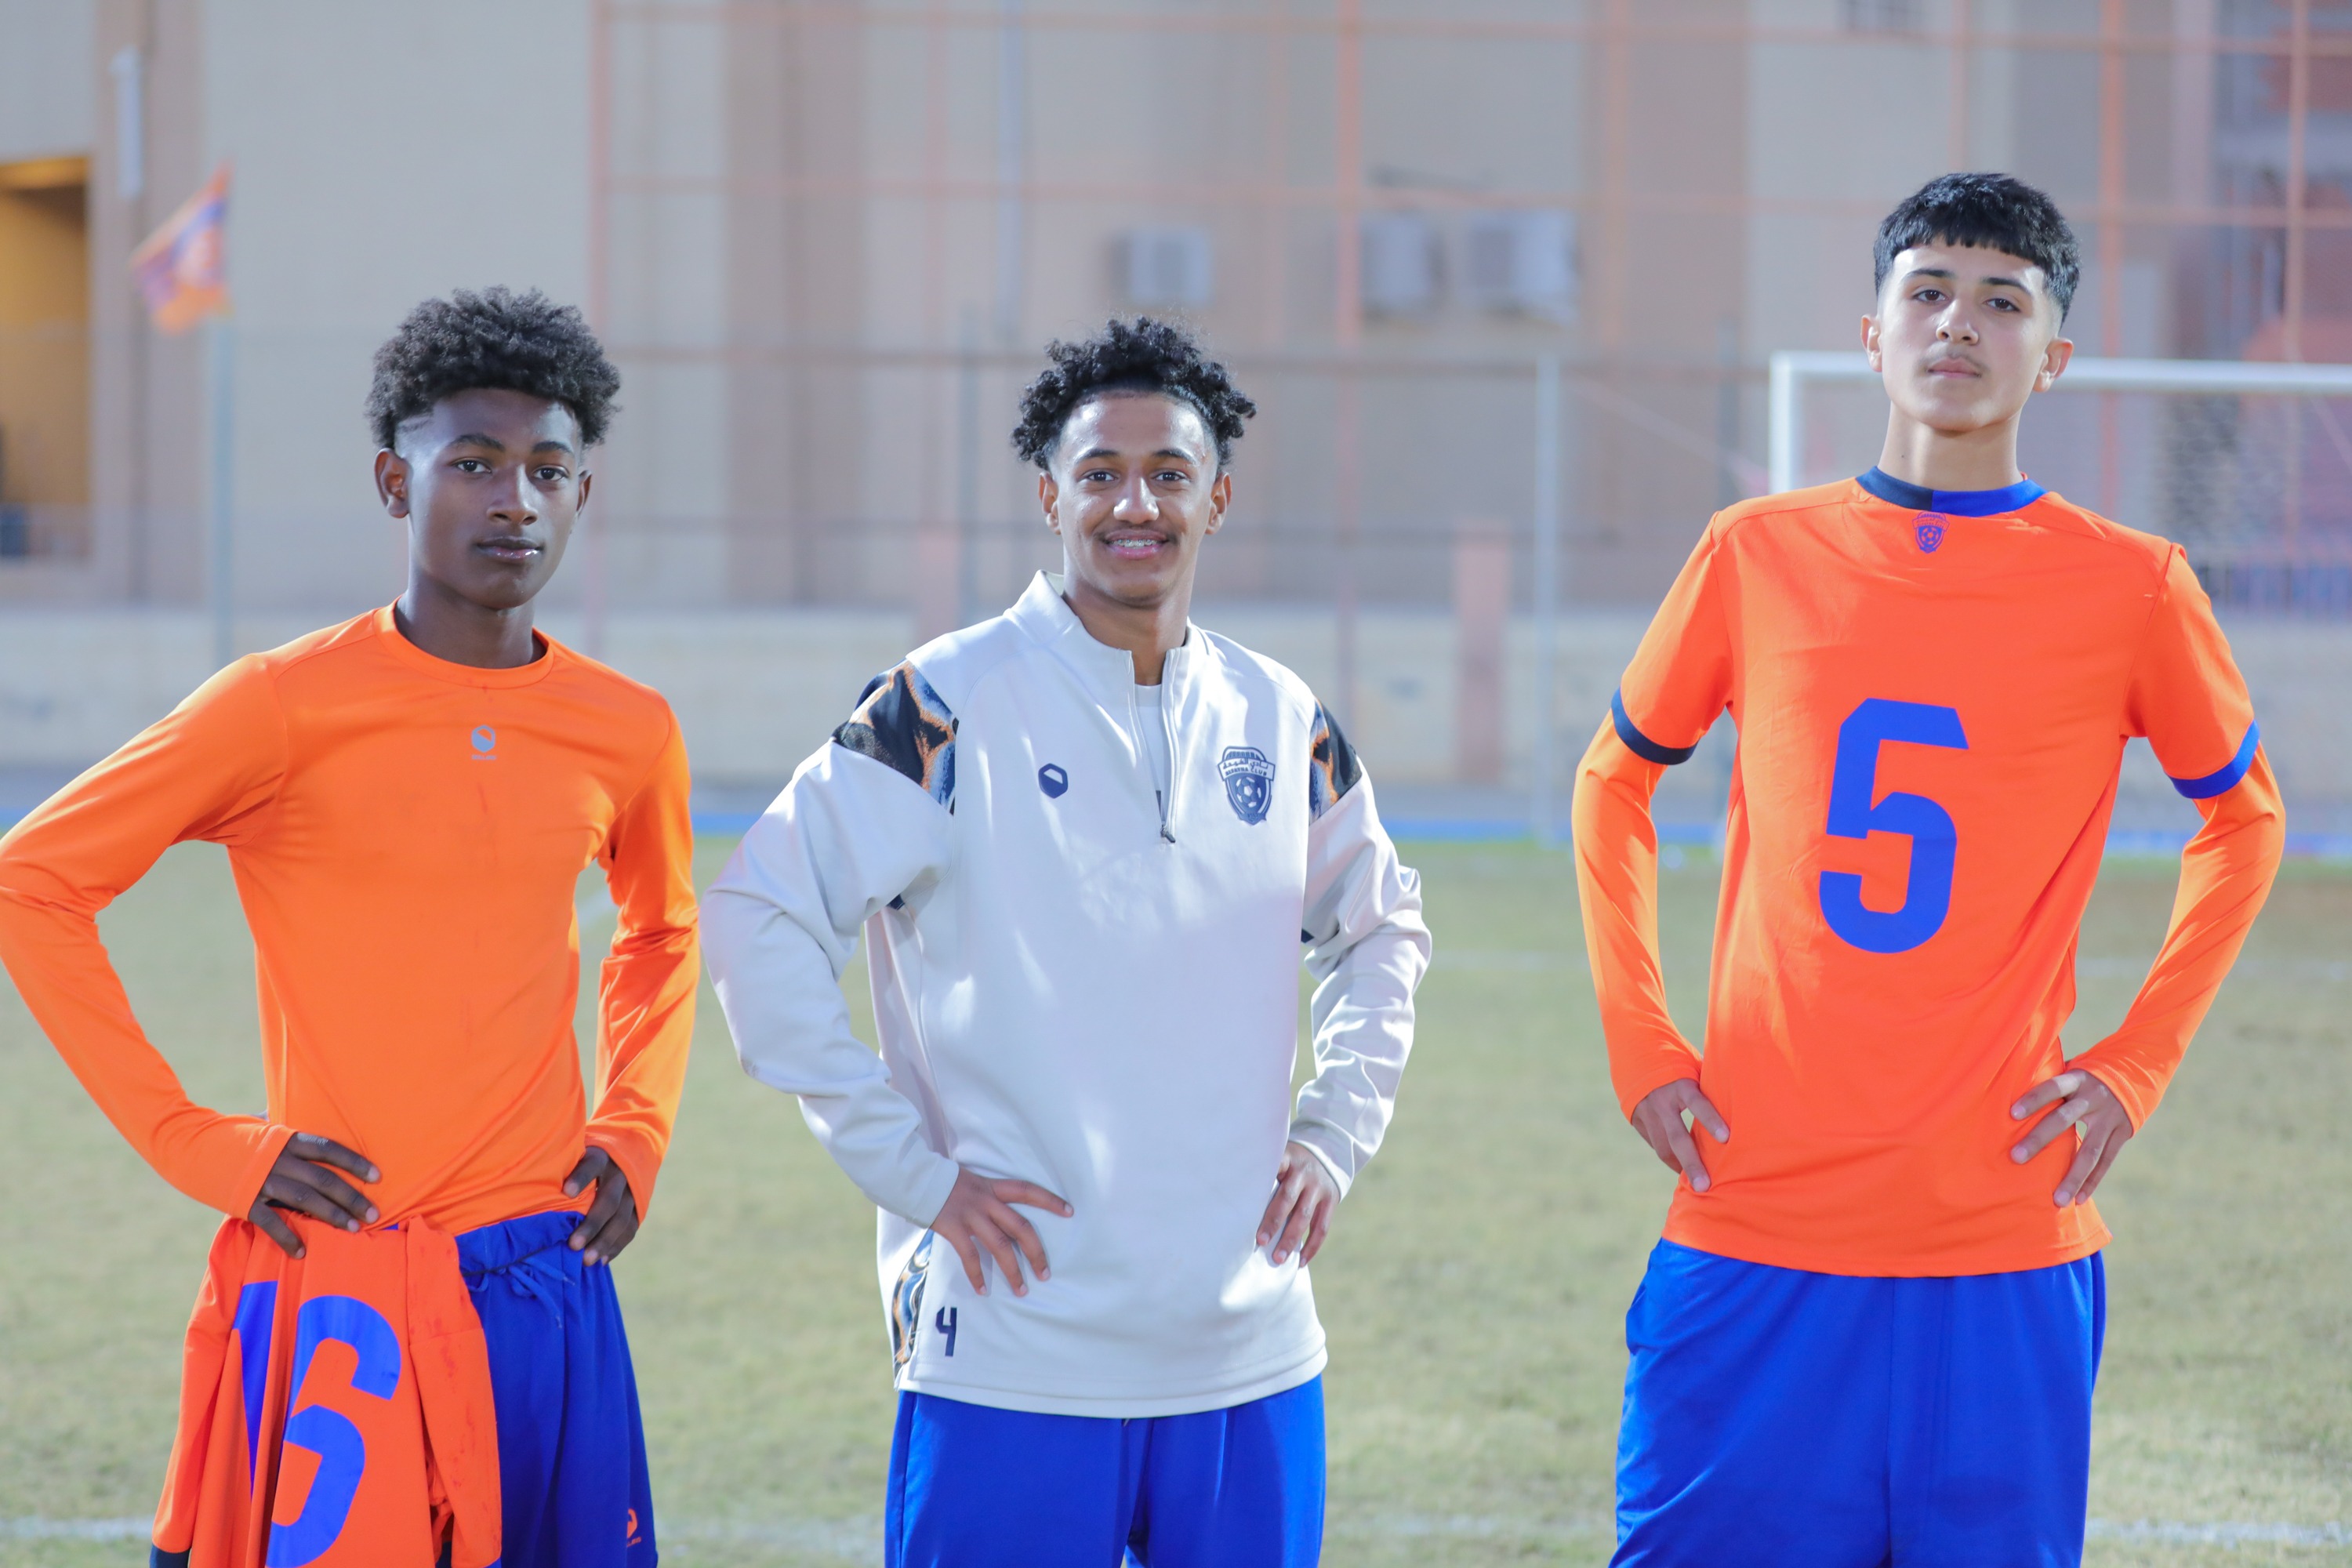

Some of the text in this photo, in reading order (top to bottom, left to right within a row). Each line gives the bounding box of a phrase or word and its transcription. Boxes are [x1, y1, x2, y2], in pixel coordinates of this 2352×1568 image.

[1250, 767, 1267, 776] CLUB
[1818, 697, 1969, 954] 5
[935, 1305, 957, 1357] 4
